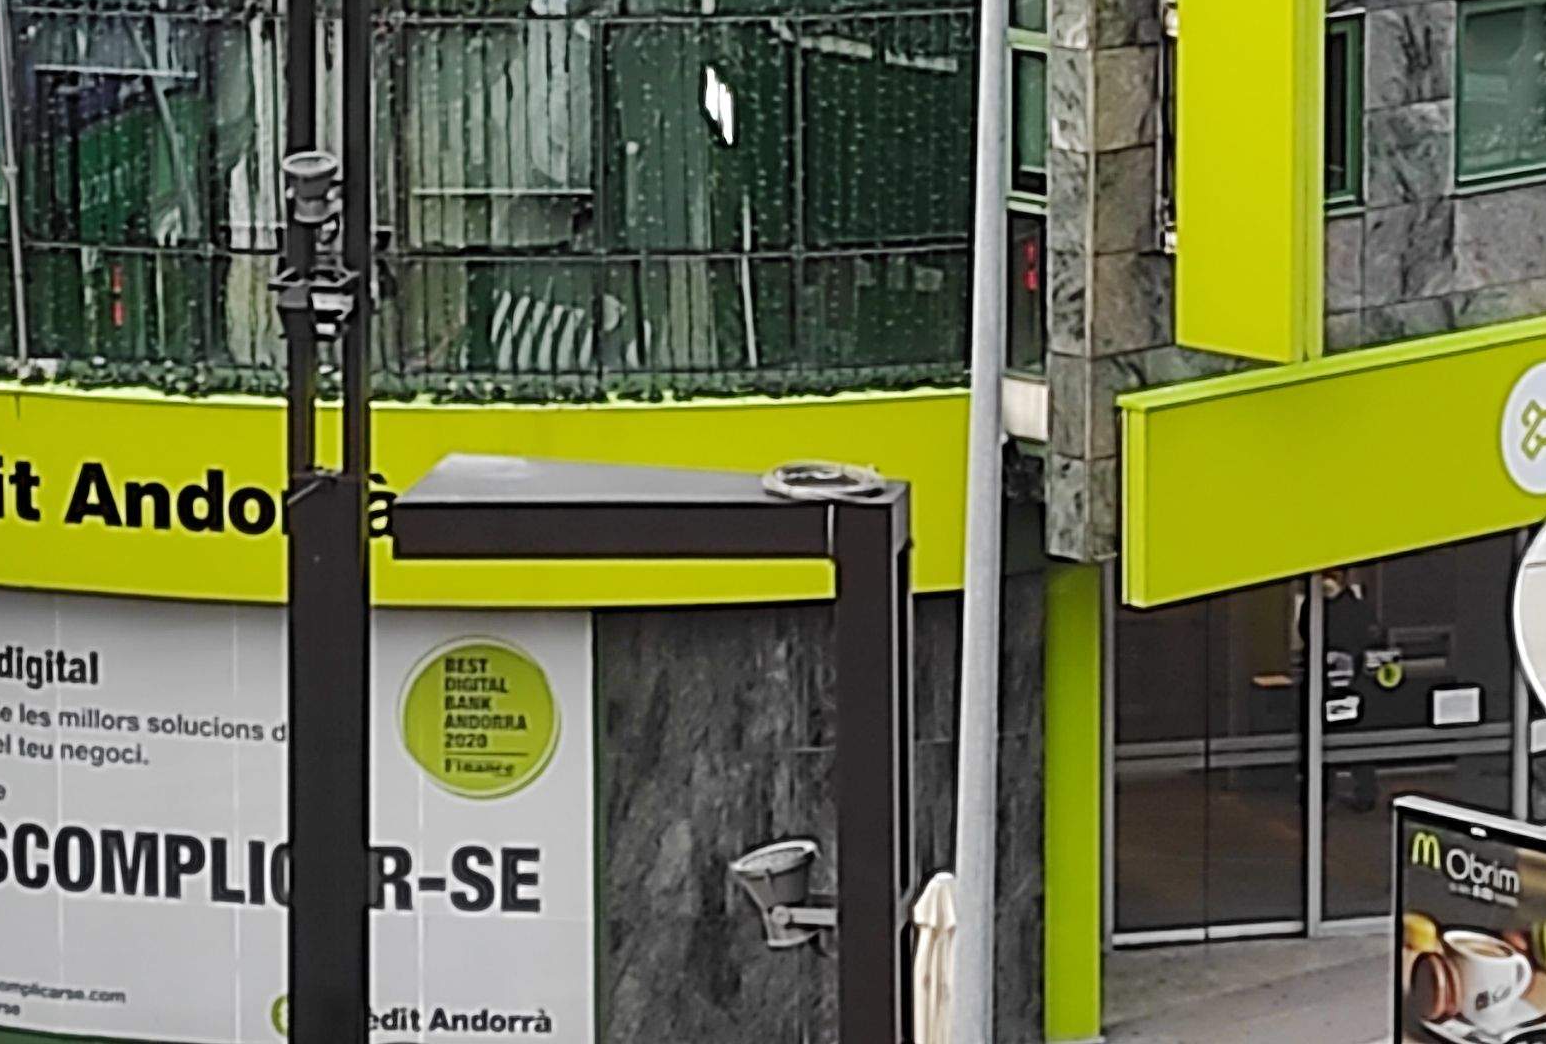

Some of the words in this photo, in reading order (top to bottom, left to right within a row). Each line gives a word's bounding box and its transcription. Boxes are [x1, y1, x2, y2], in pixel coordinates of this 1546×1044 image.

[64, 462, 398, 540] Andoà
[444, 658, 489, 674] BEST
[444, 677, 508, 694] DIGITAL
[444, 695, 492, 711] BANK
[19, 703, 51, 727] les
[58, 707, 140, 732] millors
[148, 714, 264, 741] solucions
[444, 714, 528, 731] ANDORRA
[444, 733, 488, 749] 2020
[19, 738, 54, 760] teu
[60, 742, 150, 767] negoci.
[1446, 848, 1521, 894] Obrim
[428, 1008, 553, 1034] Andorrà
